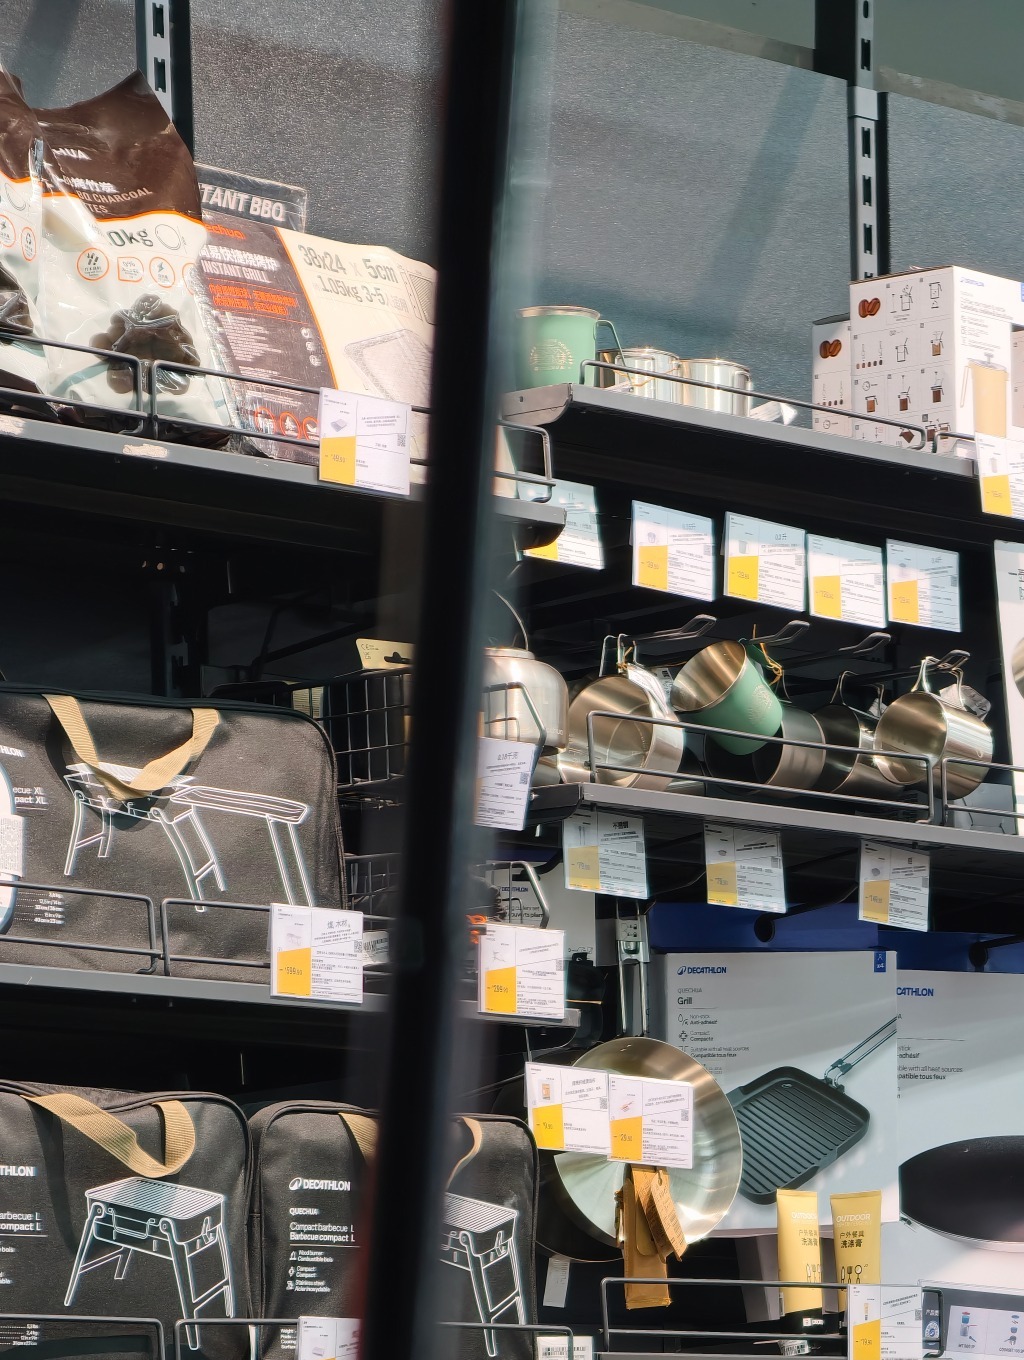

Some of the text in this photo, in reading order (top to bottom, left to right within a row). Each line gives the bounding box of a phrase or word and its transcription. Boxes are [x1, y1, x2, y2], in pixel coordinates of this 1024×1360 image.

[93, 186, 153, 204] CHARCOAL
[199, 183, 286, 221] TANT BBQ
[362, 258, 399, 283] 5cm
[688, 966, 727, 975] DECATHLON
[677, 996, 693, 1006] Grill
[303, 1179, 351, 1191] DECATHLON
[289, 1207, 318, 1216] QUECHUA
[836, 1213, 871, 1223] OUTDOOR
[289, 1221, 318, 1232] Compact
[318, 1223, 349, 1233] barbecue
[289, 1231, 319, 1241] Barbecue
[319, 1232, 349, 1243] compact
